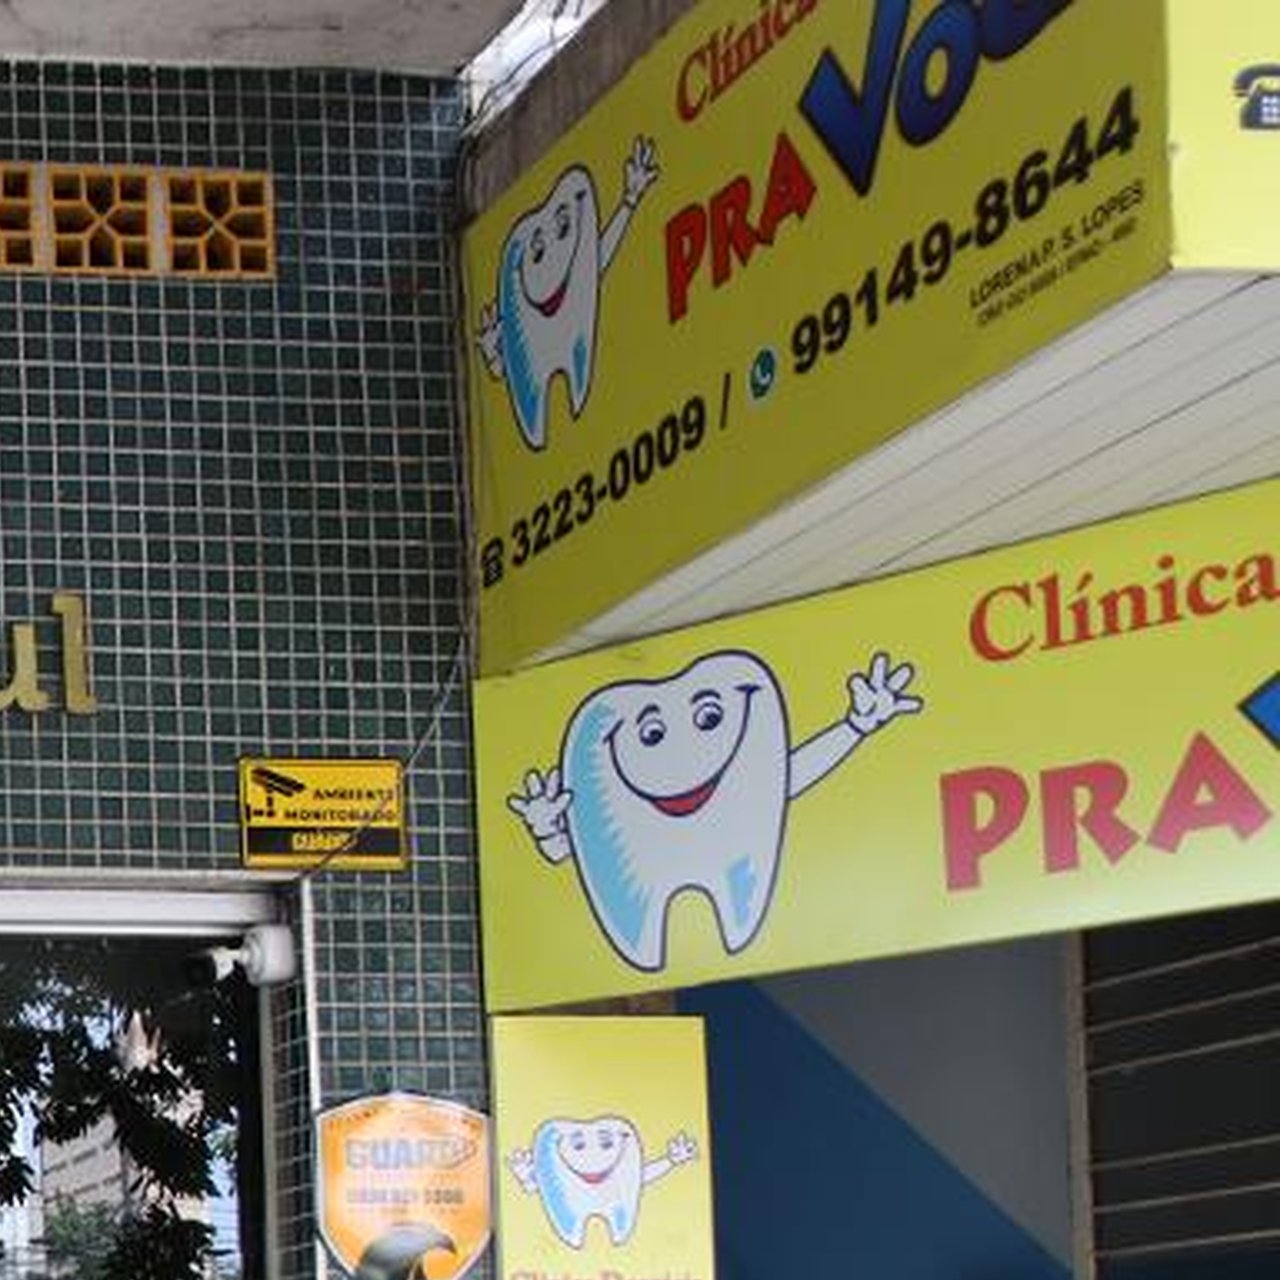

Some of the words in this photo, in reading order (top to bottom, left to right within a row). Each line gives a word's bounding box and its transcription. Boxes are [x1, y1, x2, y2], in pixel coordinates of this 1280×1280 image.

[666, 132, 817, 325] PRA
[512, 396, 706, 567] 3223-0009
[792, 86, 1139, 374] 99149-8644
[969, 554, 1280, 662] Clínica
[940, 730, 1274, 892] PRA
